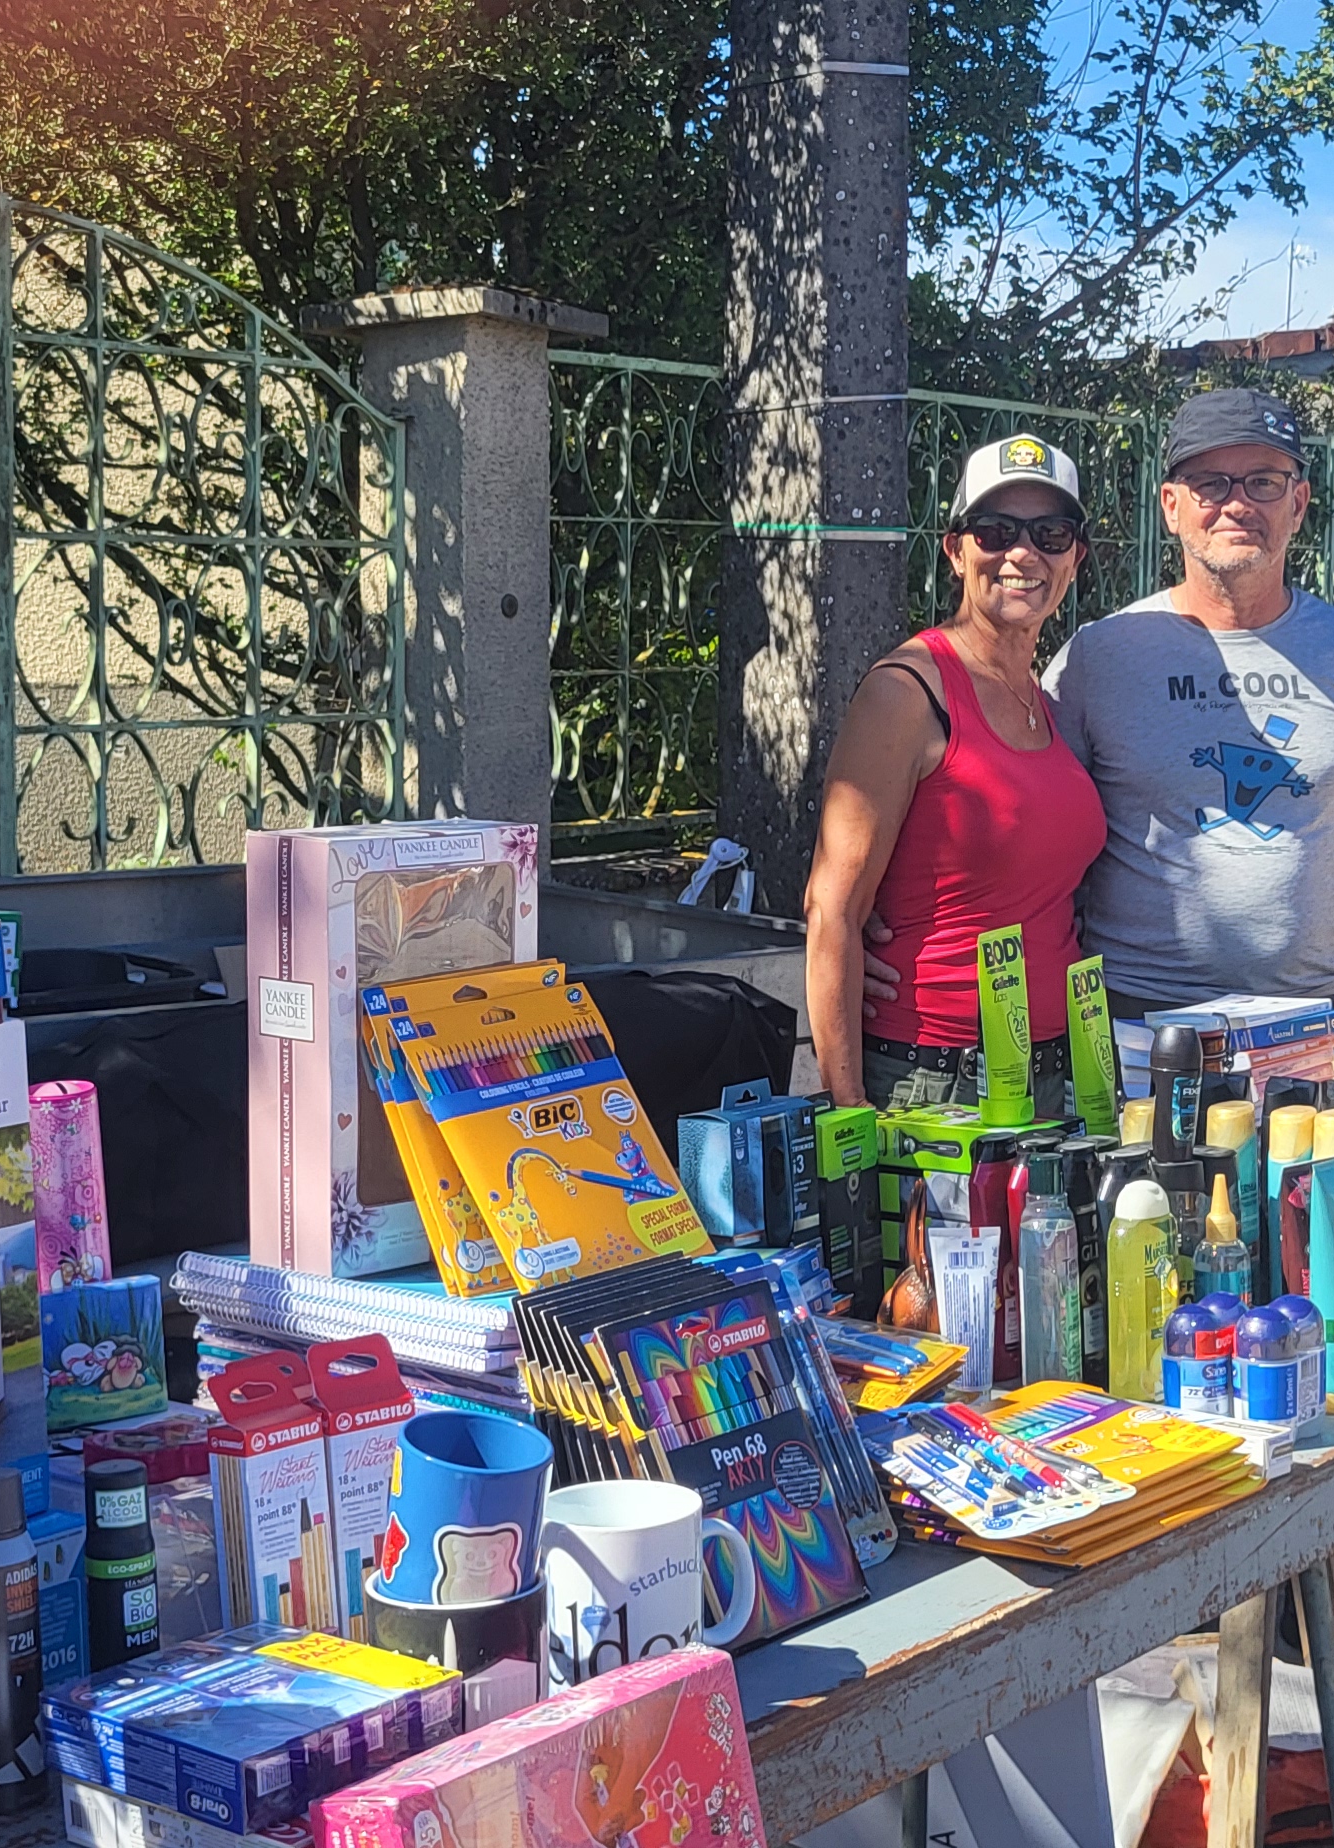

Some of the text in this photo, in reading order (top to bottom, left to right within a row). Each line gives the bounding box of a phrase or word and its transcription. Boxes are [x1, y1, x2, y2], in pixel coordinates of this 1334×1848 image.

[1168, 672, 1311, 701] M. COOL
[396, 837, 479, 855] YANKEE CANDLE
[331, 838, 390, 894] Love
[281, 840, 290, 917] YANKEE CANDLE
[281, 925, 291, 962] CANDLE
[982, 935, 1024, 968] BODY
[991, 974, 1020, 992] Gillette
[1072, 967, 1105, 999] BODY
[265, 988, 307, 1006] YANKEE
[368, 993, 389, 1011] x24
[265, 1003, 308, 1021] CANDLE
[396, 1020, 415, 1038] x24
[282, 1048, 291, 1085] YANKEE
[282, 1092, 291, 1168] YANKEE CANDLE
[793, 1154, 806, 1174] i3
[283, 1175, 292, 1249] YANKEE CANDLE
[722, 1322, 767, 1347] STABILO
[355, 1402, 414, 1426] STABILO
[267, 1421, 321, 1447] STABILO
[712, 1433, 768, 1471] Pen 68
[339, 1474, 350, 1486] 18
[727, 1452, 768, 1491] ARTY
[117, 1492, 143, 1507] GAZ
[255, 1497, 265, 1509] 18
[340, 1486, 365, 1501] point
[100, 1505, 143, 1518] ALCOOL
[257, 1510, 280, 1526] point
[5, 1562, 39, 1587] ADIDAS
[130, 1587, 154, 1607] SO
[9, 1628, 35, 1655] 72H
[127, 1627, 158, 1648] MEN
[190, 1794, 229, 1820] Oral-B
